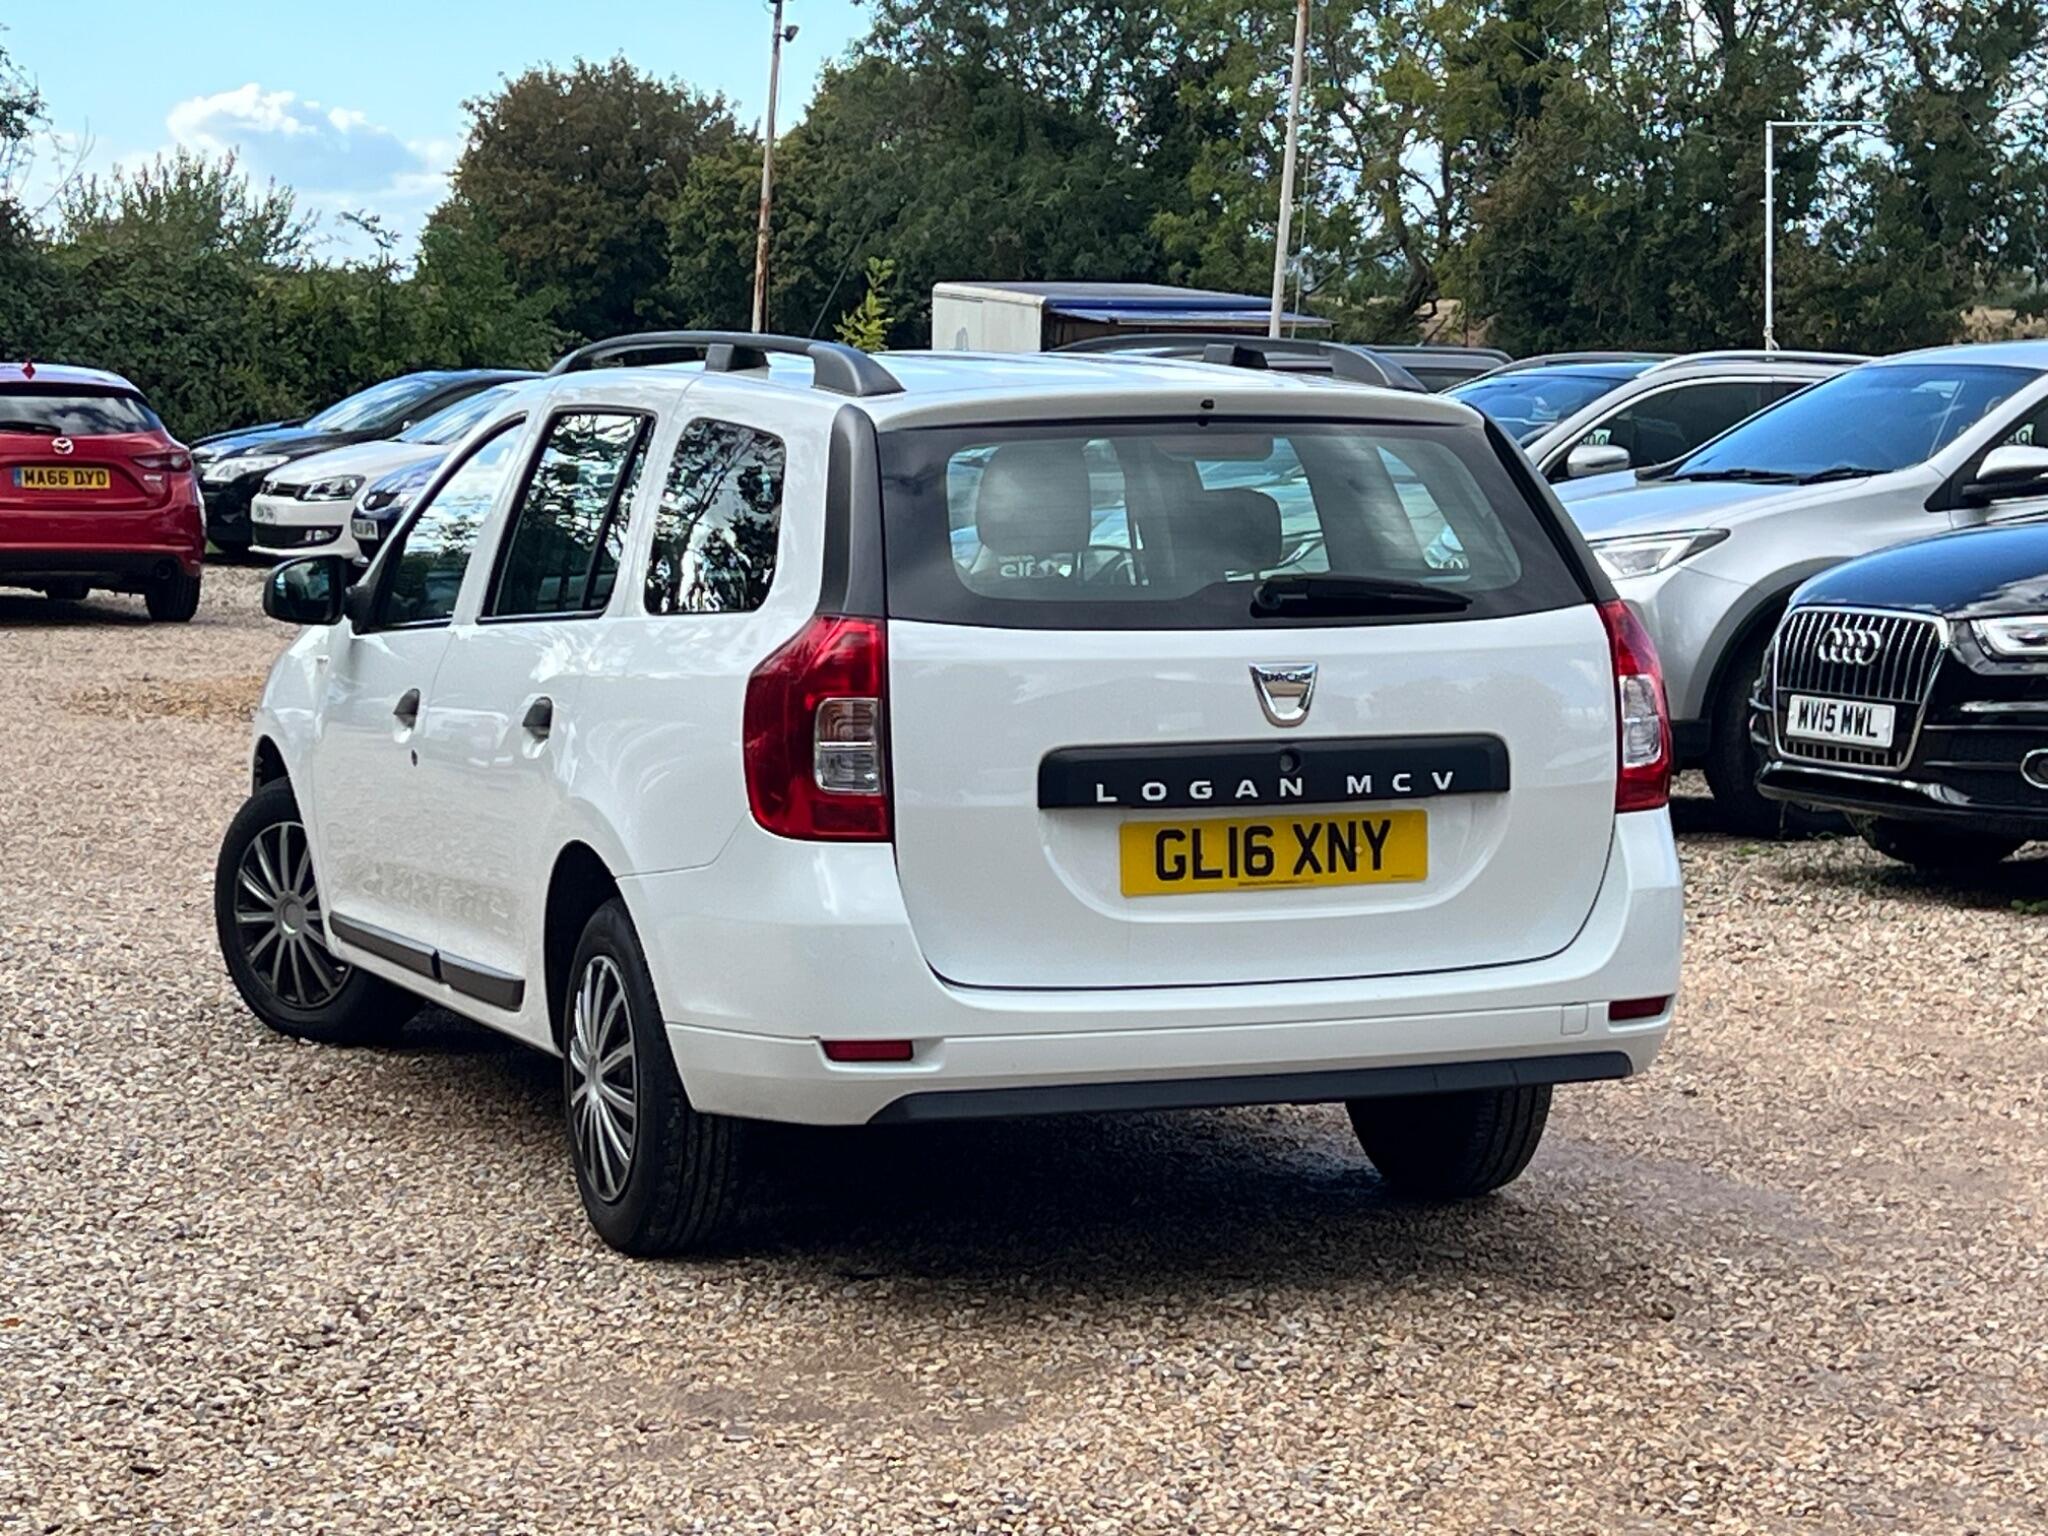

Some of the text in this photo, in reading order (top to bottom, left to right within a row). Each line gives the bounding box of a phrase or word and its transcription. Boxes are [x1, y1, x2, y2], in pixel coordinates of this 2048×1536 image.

[24, 470, 69, 485] MA66
[1797, 700, 1878, 738] MV15 MWL
[1096, 772, 1454, 803] LOGAN MCV
[1155, 819, 1391, 881] GL16 XNY
